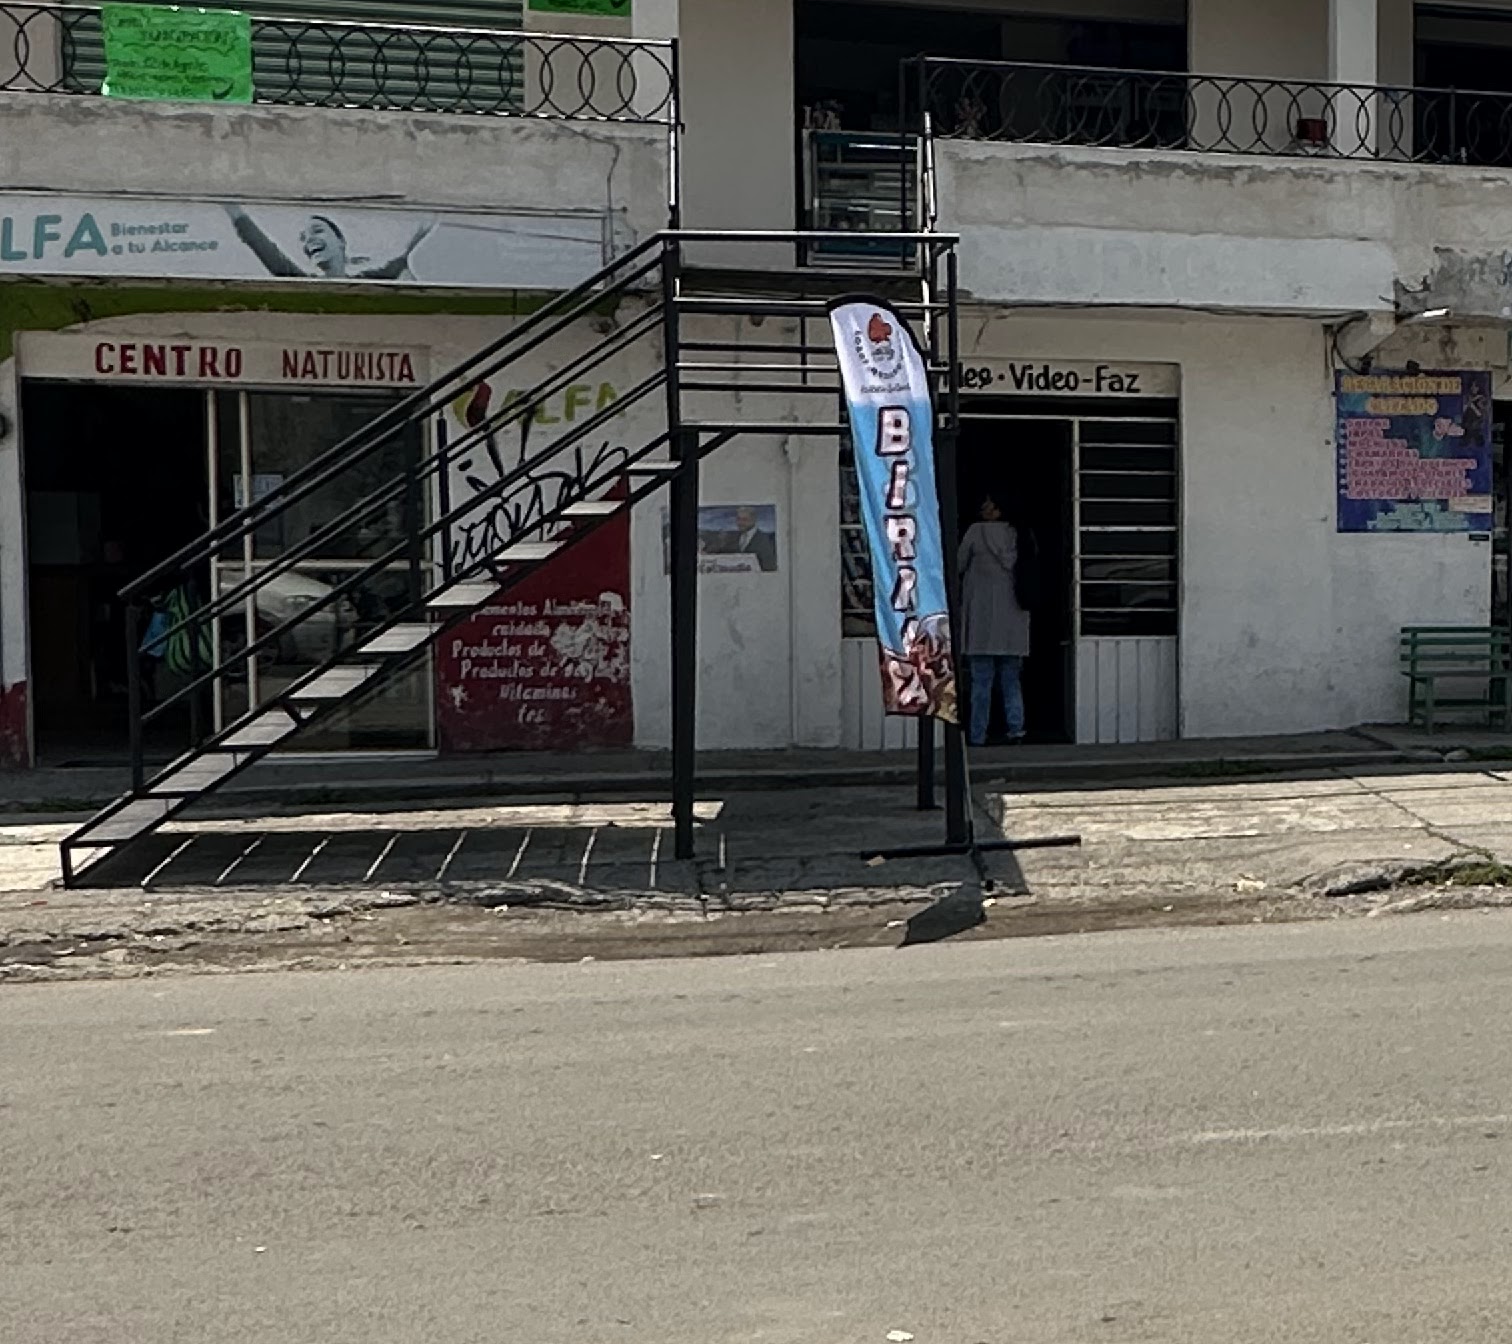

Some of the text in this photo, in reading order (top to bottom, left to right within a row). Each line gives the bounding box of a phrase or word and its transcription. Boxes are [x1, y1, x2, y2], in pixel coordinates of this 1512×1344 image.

[1, 212, 190, 261] LFA Bienestar
[110, 239, 219, 256] a tu Alcance
[94, 342, 416, 382] CENTRO NATURISTA
[1009, 363, 1142, 393] Video-Faz
[452, 638, 522, 658] Productos
[460, 658, 534, 680] Productos
